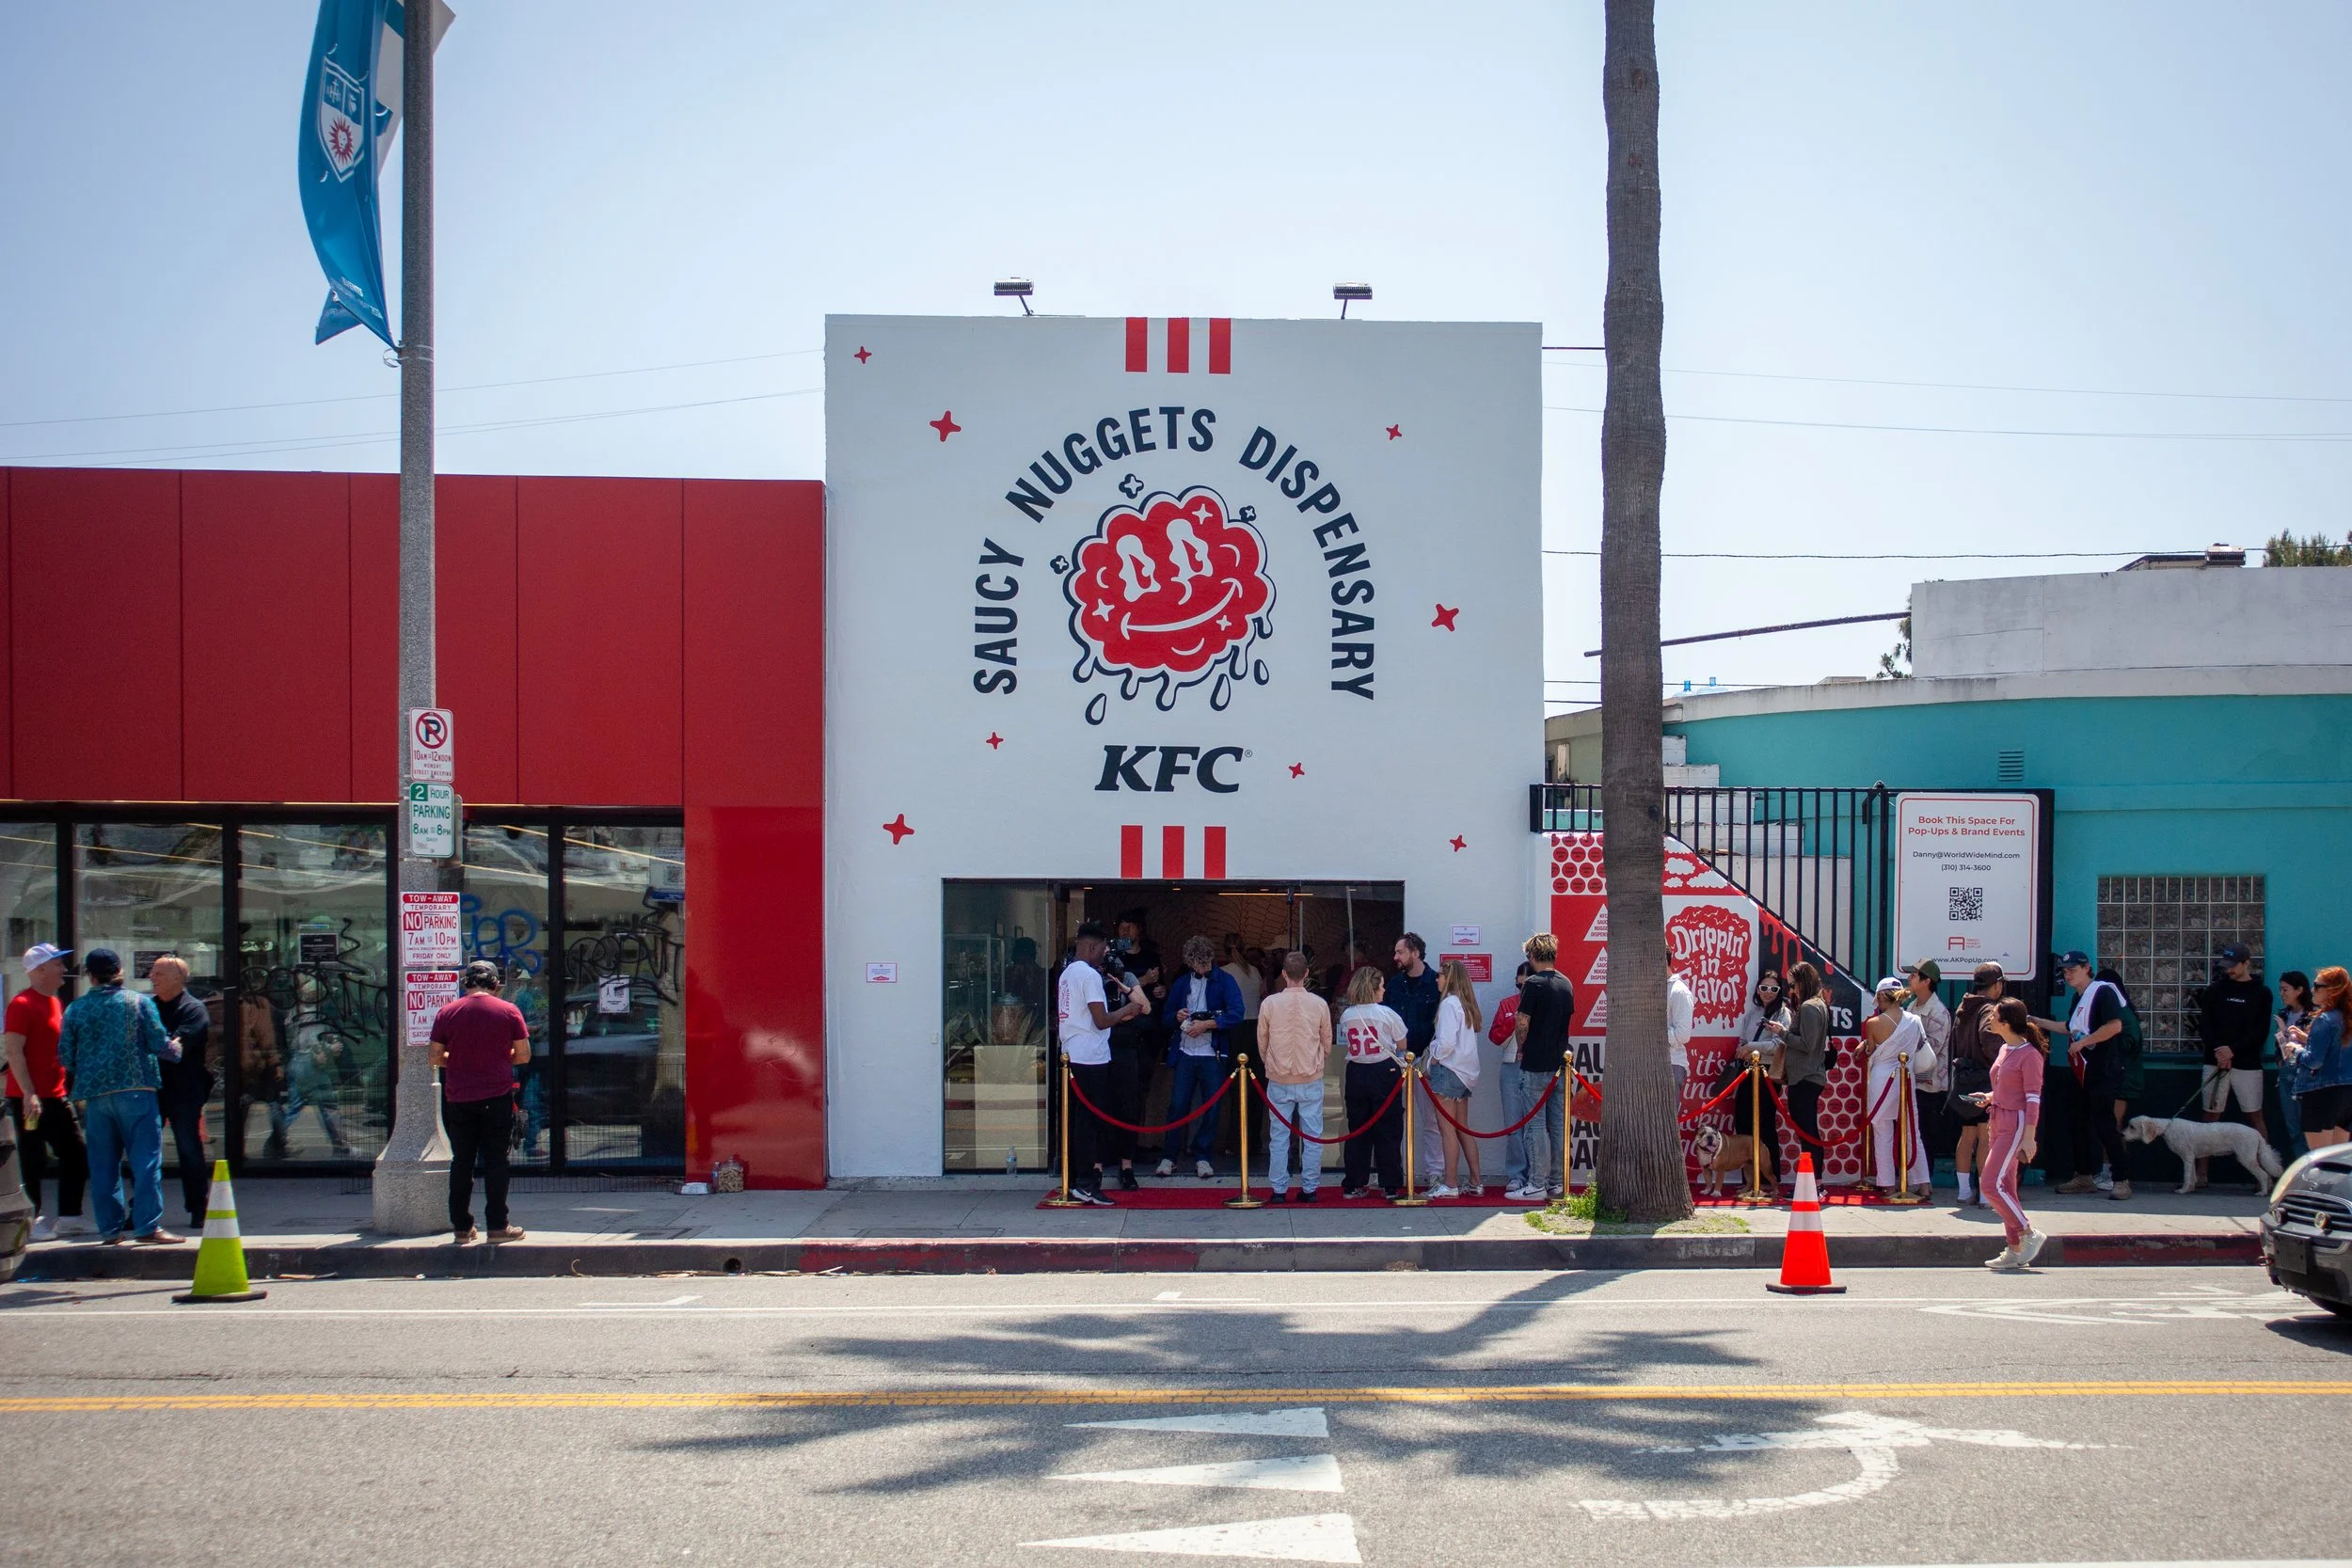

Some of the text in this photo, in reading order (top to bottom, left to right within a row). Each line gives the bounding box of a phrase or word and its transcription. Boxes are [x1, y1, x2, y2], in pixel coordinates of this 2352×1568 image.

[973, 406, 1375, 701] SAUCY NUGGETS DISPENSARY
[1094, 744, 1244, 793] KFC
[415, 784, 450, 800] 2 HOUR
[413, 804, 451, 819] PARKING
[1918, 816, 2016, 826] Book This Space For
[413, 823, 428, 835] 8AM
[437, 824, 452, 835] 8PM
[1908, 828, 1949, 837] Pop-Ups
[1961, 828, 1990, 836] Brand
[1993, 828, 2026, 836] Events
[1913, 851, 2020, 860] Danny@WorldWideMind.com
[1941, 863, 1957, 872] (310)
[408, 895, 453, 903] TOW-AWAY
[405, 912, 457, 929] NO PARKING
[408, 932, 425, 945] 7AM
[435, 931, 456, 945] 10PM
[1699, 955, 1720, 976] in
[412, 974, 453, 982] TOW-AWAY
[409, 992, 424, 1009] NO
[411, 1012, 427, 1024] 7AM
[1347, 1025, 1380, 1056] 62
